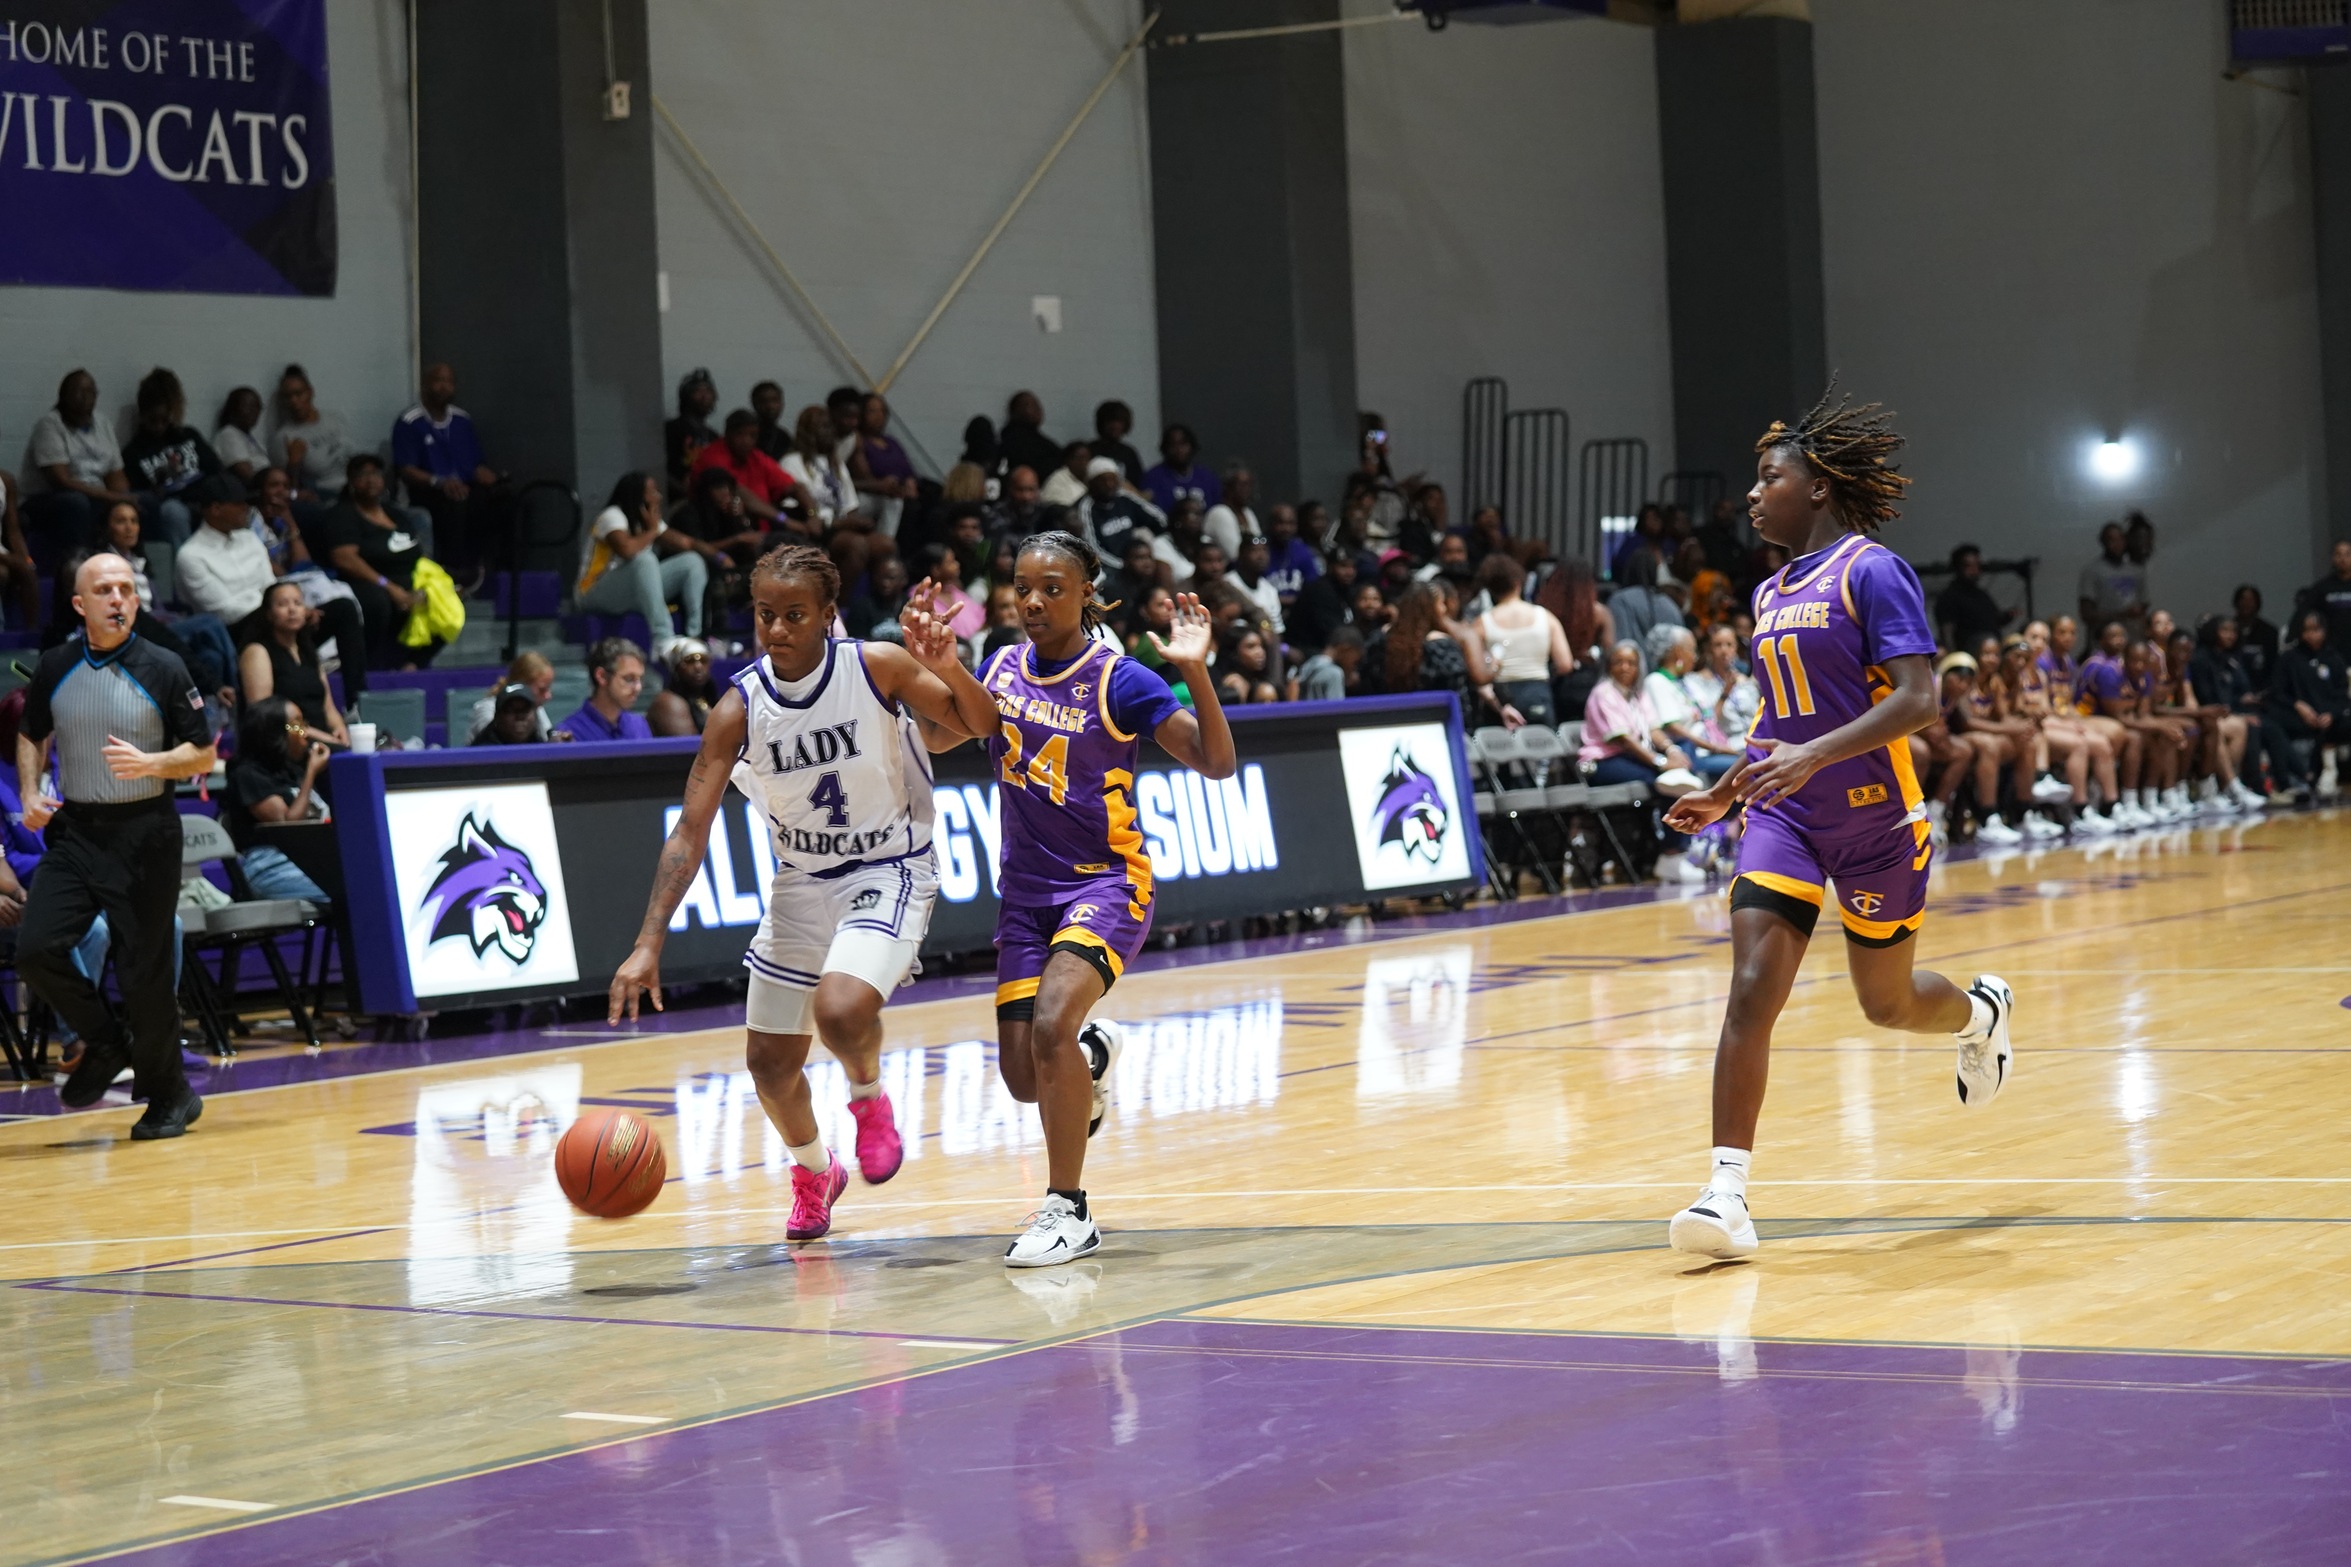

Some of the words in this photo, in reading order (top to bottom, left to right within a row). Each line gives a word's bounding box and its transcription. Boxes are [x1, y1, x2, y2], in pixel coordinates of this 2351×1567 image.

[0, 19, 110, 70] HOME
[120, 30, 170, 75] OF
[179, 35, 256, 83] THE
[1773, 601, 1831, 631] COLLEGE
[1757, 633, 1817, 720] 11
[1024, 699, 1088, 734] COLLEGE
[766, 719, 862, 775] LADY
[999, 720, 1071, 806] 24
[806, 770, 851, 828] 4
